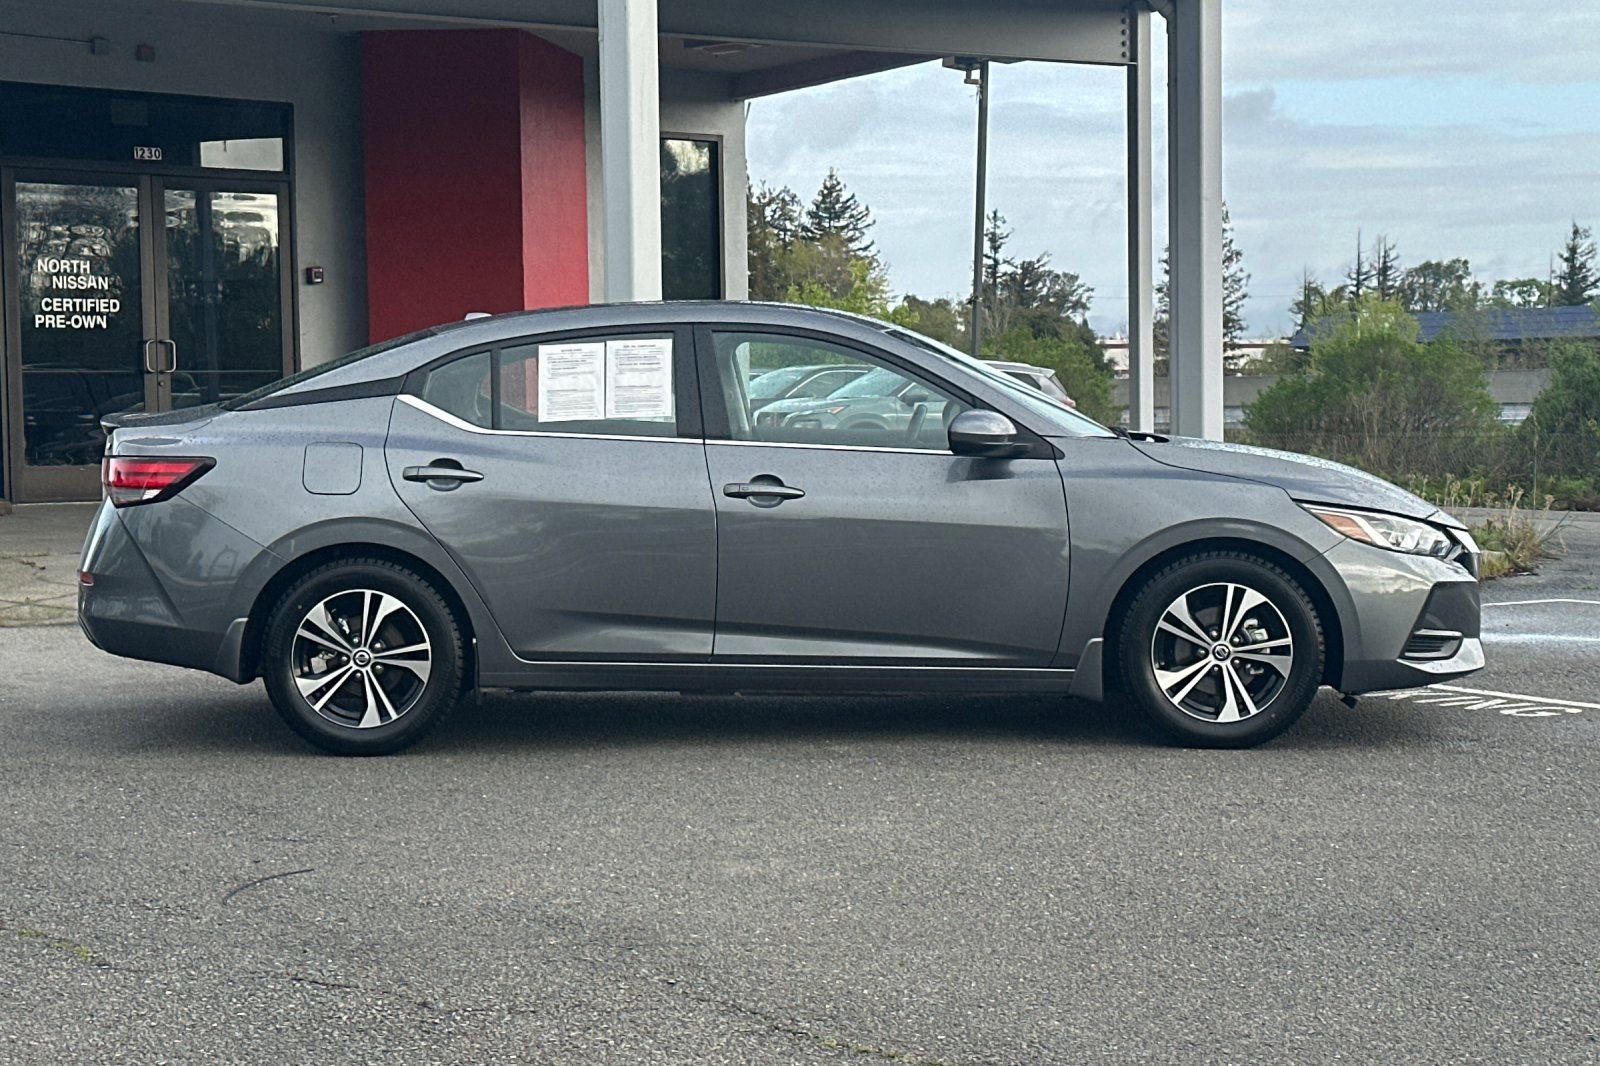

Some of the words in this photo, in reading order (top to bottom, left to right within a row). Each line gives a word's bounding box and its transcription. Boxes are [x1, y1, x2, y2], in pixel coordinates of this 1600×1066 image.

[134, 147, 161, 159] 1230
[37, 259, 90, 273] NORTH
[52, 275, 109, 290] NISSAN
[41, 297, 120, 312] CERTIFIED
[35, 314, 107, 329] PRE-OWN
